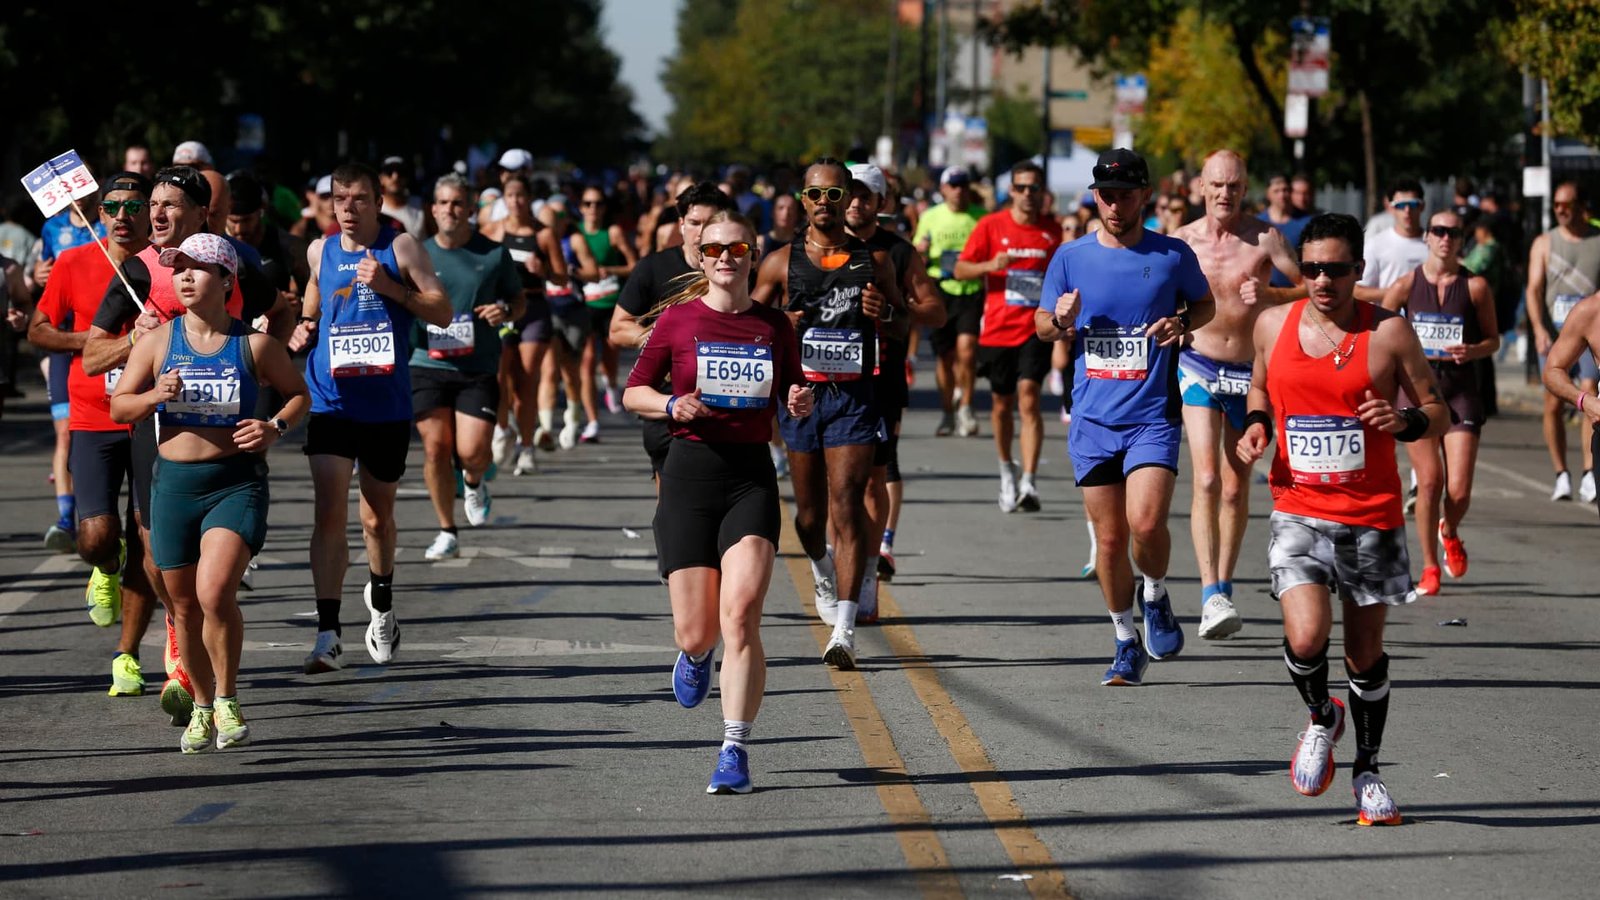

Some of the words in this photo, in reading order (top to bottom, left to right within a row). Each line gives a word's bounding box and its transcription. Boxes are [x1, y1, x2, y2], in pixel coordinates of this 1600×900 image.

[332, 335, 391, 356] F45902
[803, 343, 860, 361] D16563
[1087, 340, 1142, 358] F41991
[706, 360, 765, 382] E6946
[169, 382, 237, 402] 13917
[1289, 433, 1361, 457] F29176
